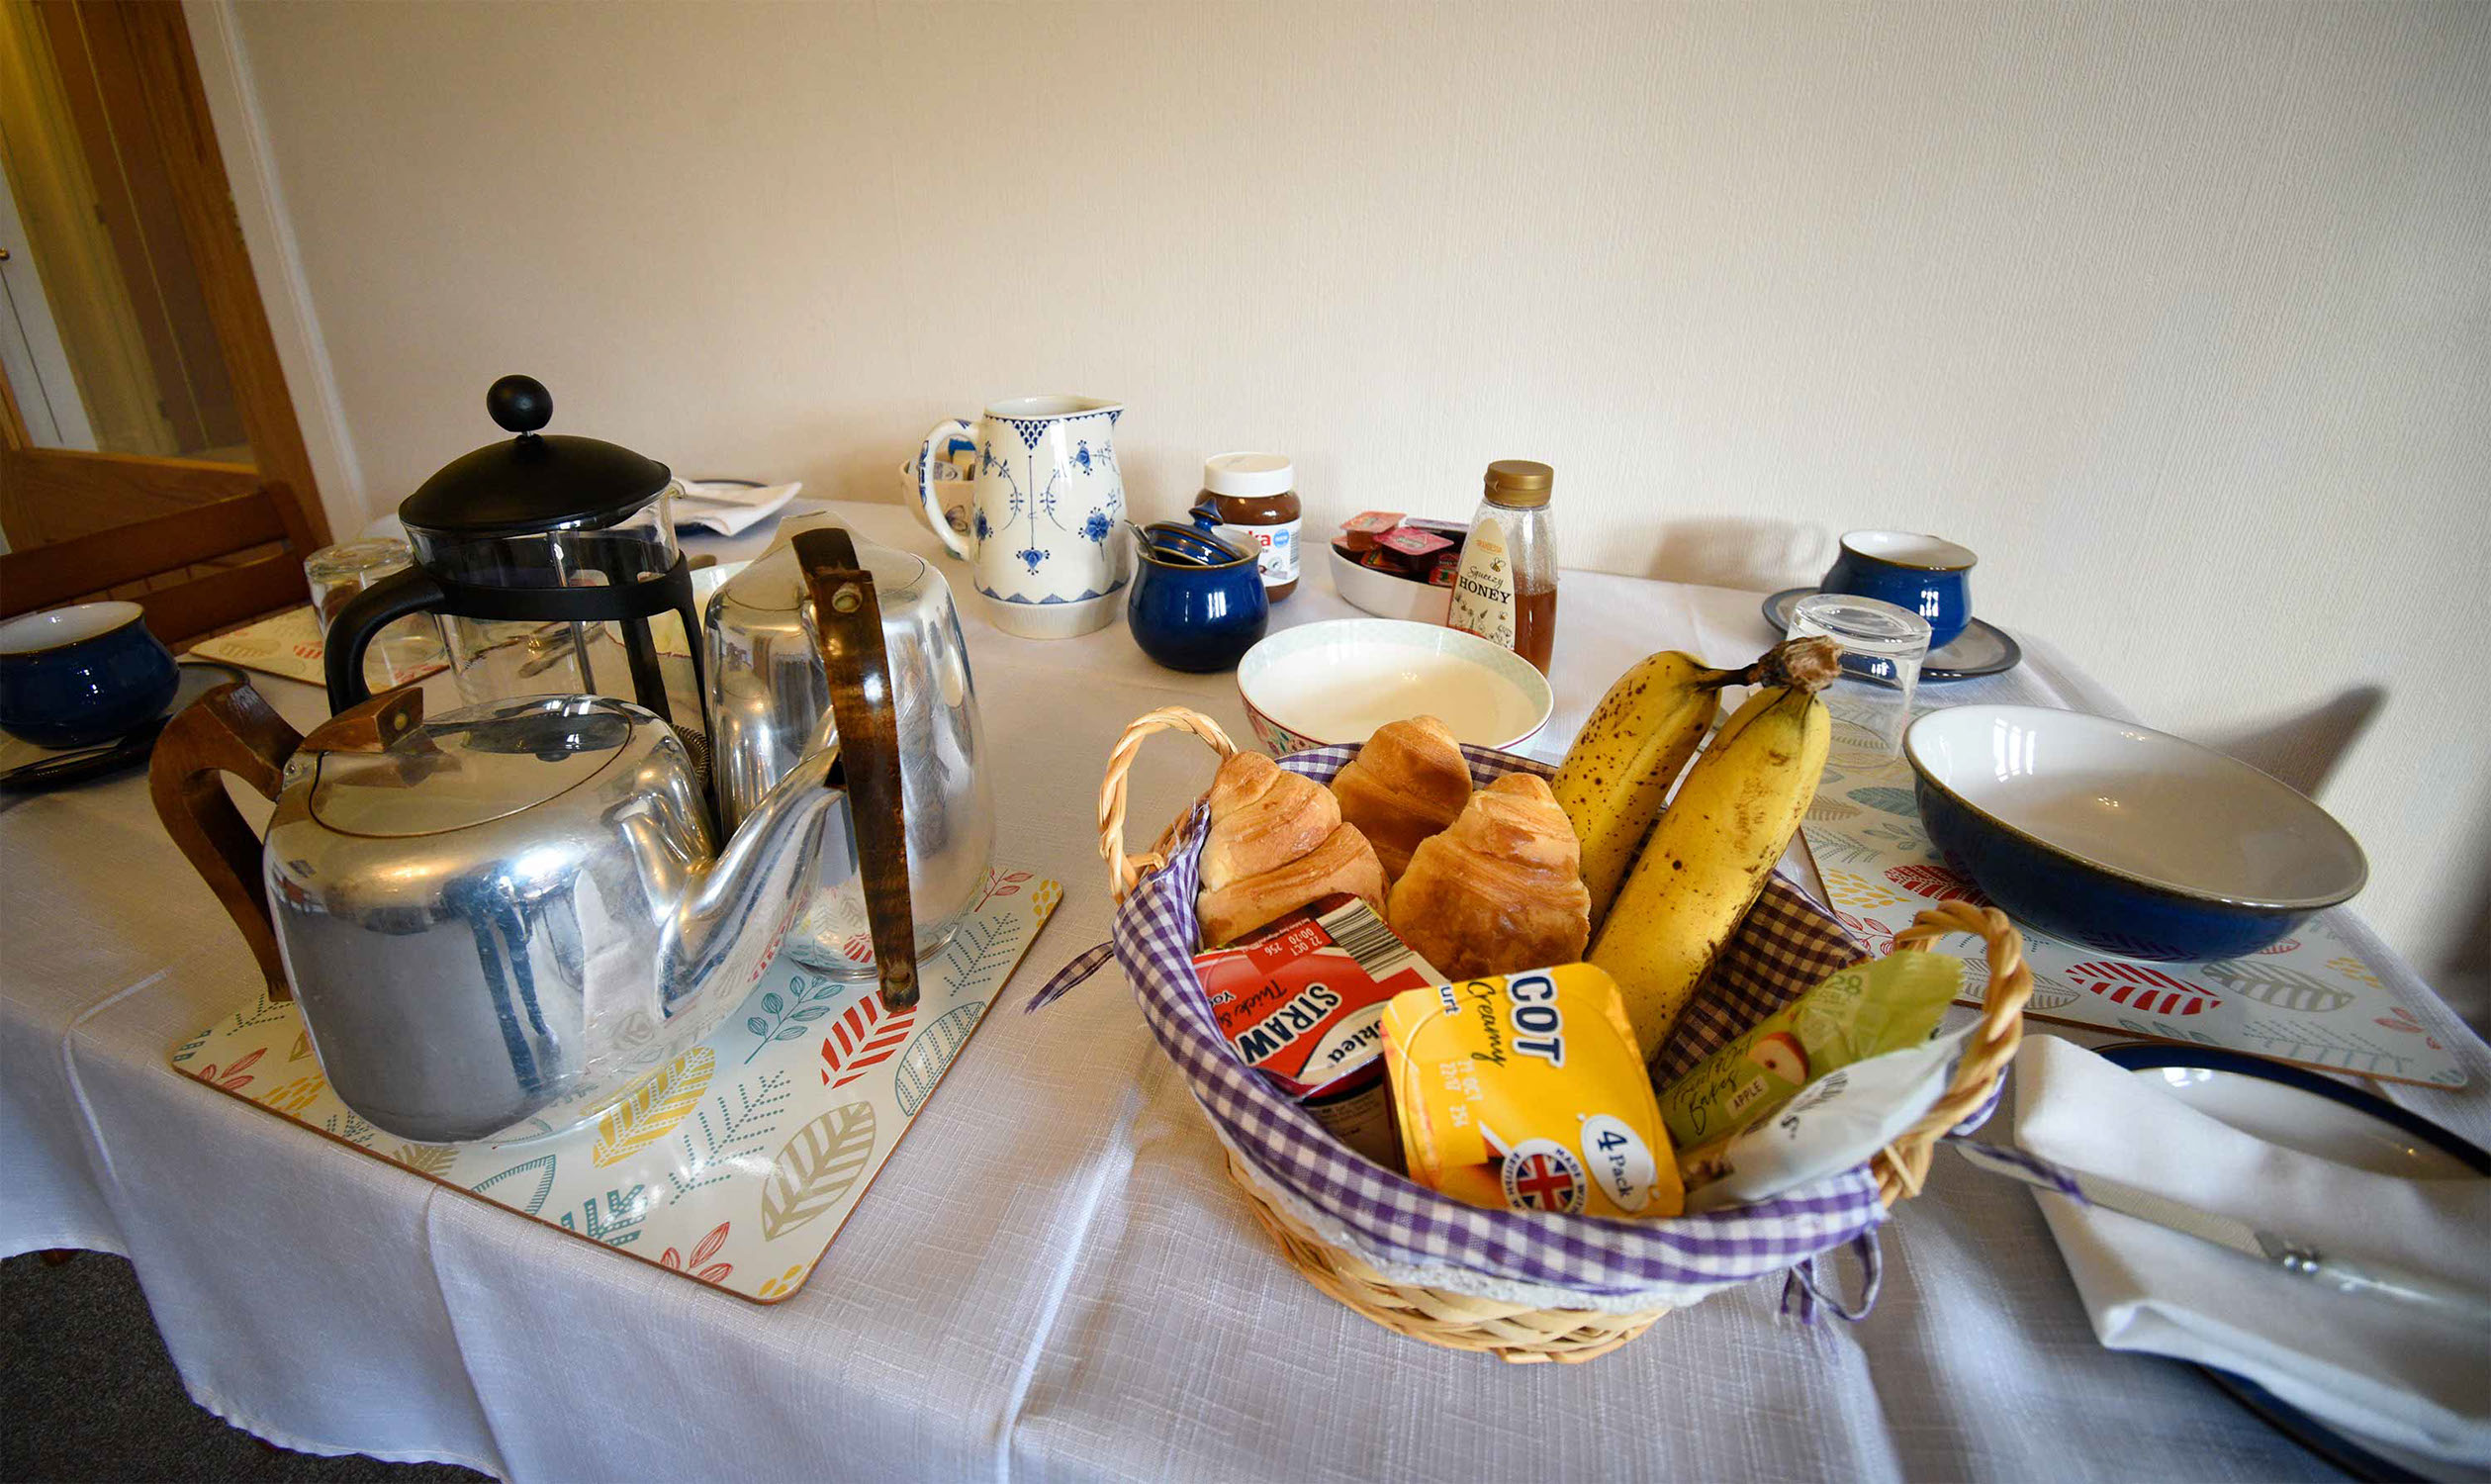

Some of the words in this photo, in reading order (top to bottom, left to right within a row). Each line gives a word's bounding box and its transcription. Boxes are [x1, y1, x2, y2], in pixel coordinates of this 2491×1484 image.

[1459, 575, 1512, 604] HONEY
[1467, 565, 1504, 589] Squeezy
[1264, 942, 1283, 957] 256
[1290, 942, 1309, 957] OCT
[1309, 938, 1323, 947] 22
[1237, 979, 1287, 1016] Thick
[1237, 984, 1340, 1065] STRAW
[1467, 981, 1507, 1068] Creamy
[1512, 975, 1560, 1063] COT
[1733, 1082, 1763, 1110] APPLE
[1598, 1131, 1628, 1152] 4
[1610, 1155, 1634, 1197] Pack
